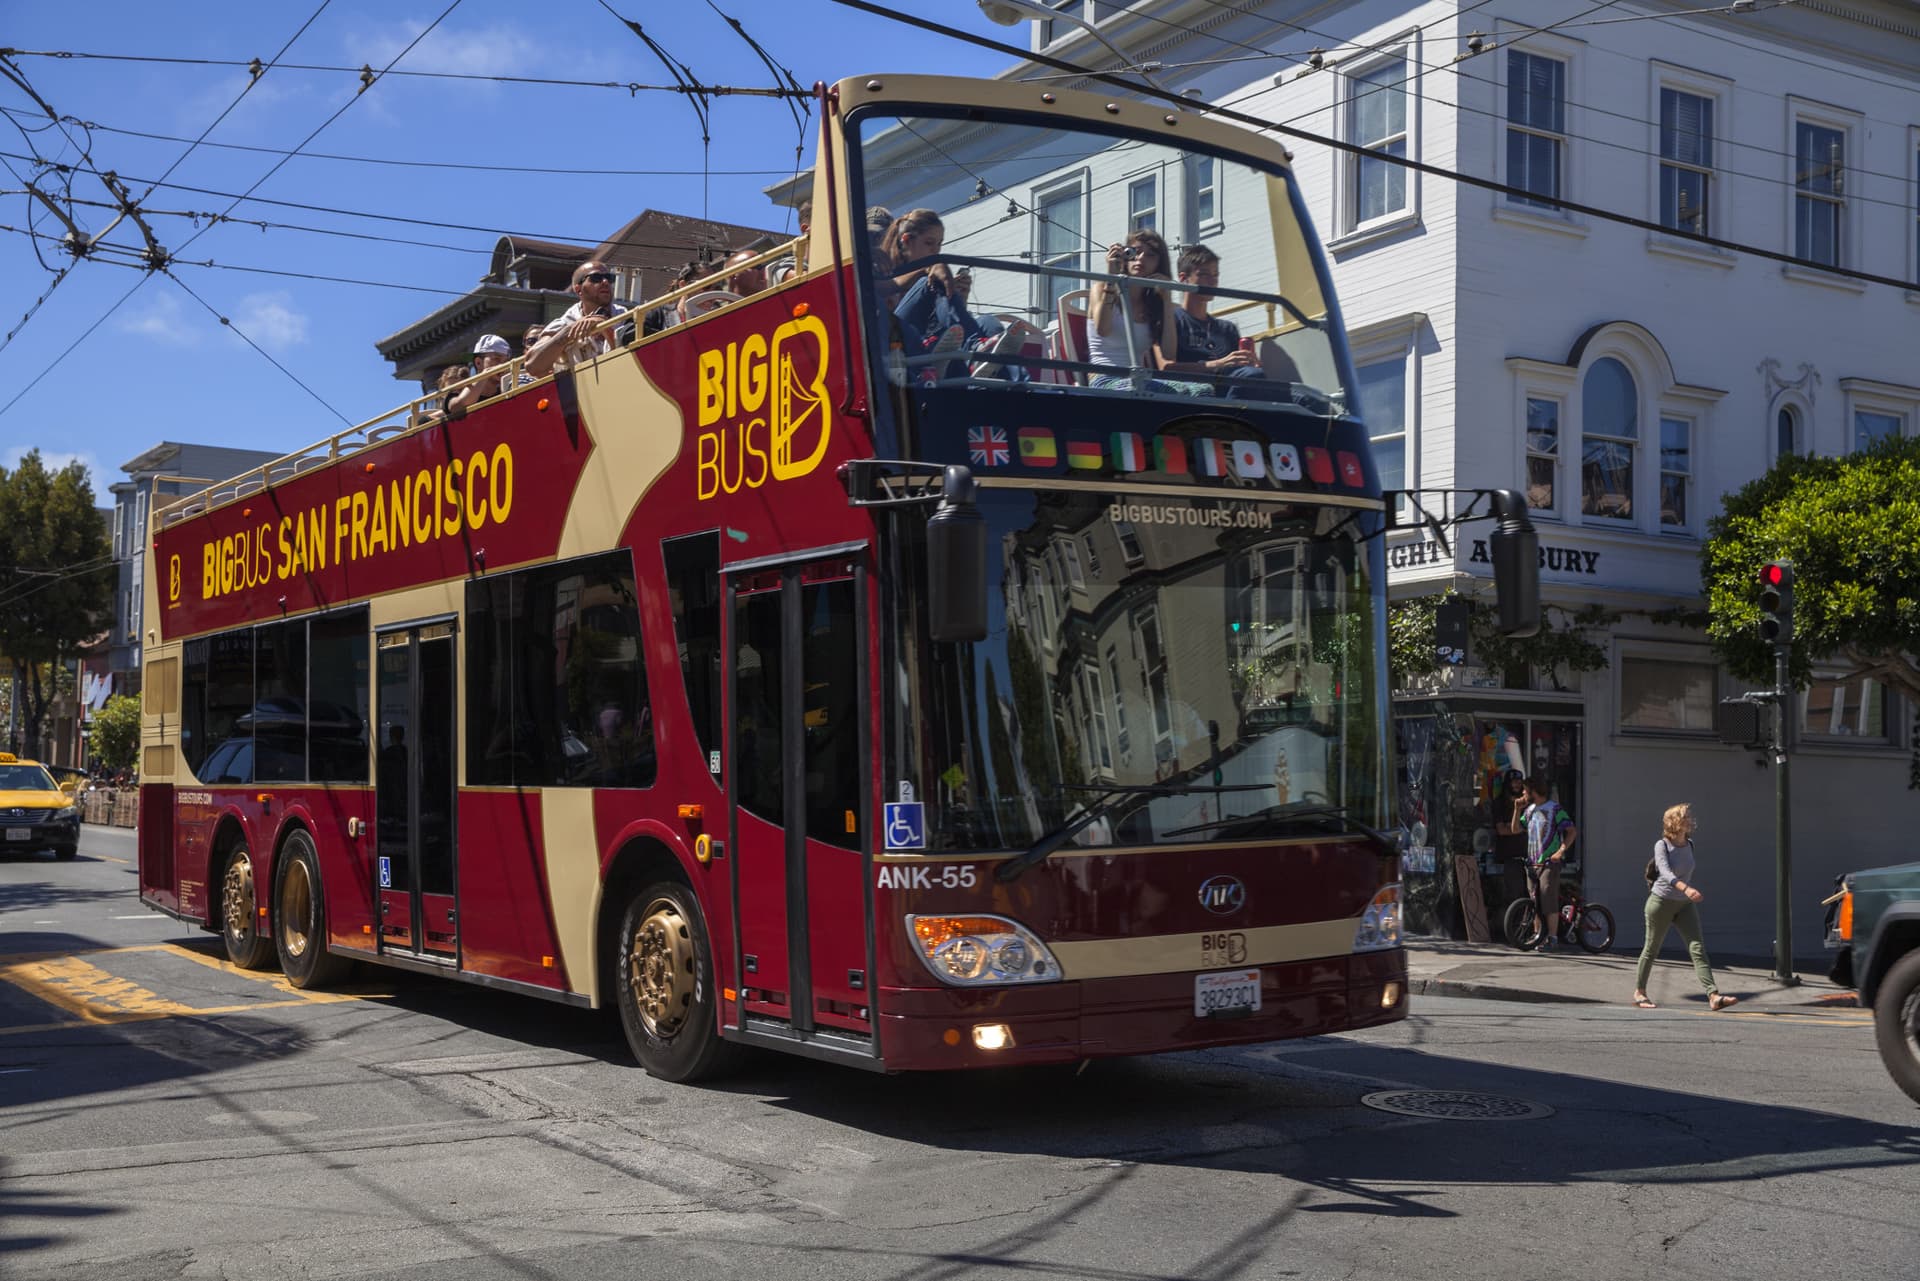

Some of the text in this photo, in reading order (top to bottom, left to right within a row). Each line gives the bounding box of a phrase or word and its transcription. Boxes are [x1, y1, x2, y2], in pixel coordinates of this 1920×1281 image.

[698, 333, 768, 427] BIG
[698, 418, 768, 501] BUS
[277, 503, 327, 580] SAN
[335, 443, 513, 565] FRANCISCO
[1109, 503, 1273, 529] BIGBUSTOURS.COM
[1386, 540, 1440, 569] GHT
[1469, 539, 1600, 574] AURY
[876, 864, 977, 889] ANK-55
[1202, 934, 1227, 951] BIG
